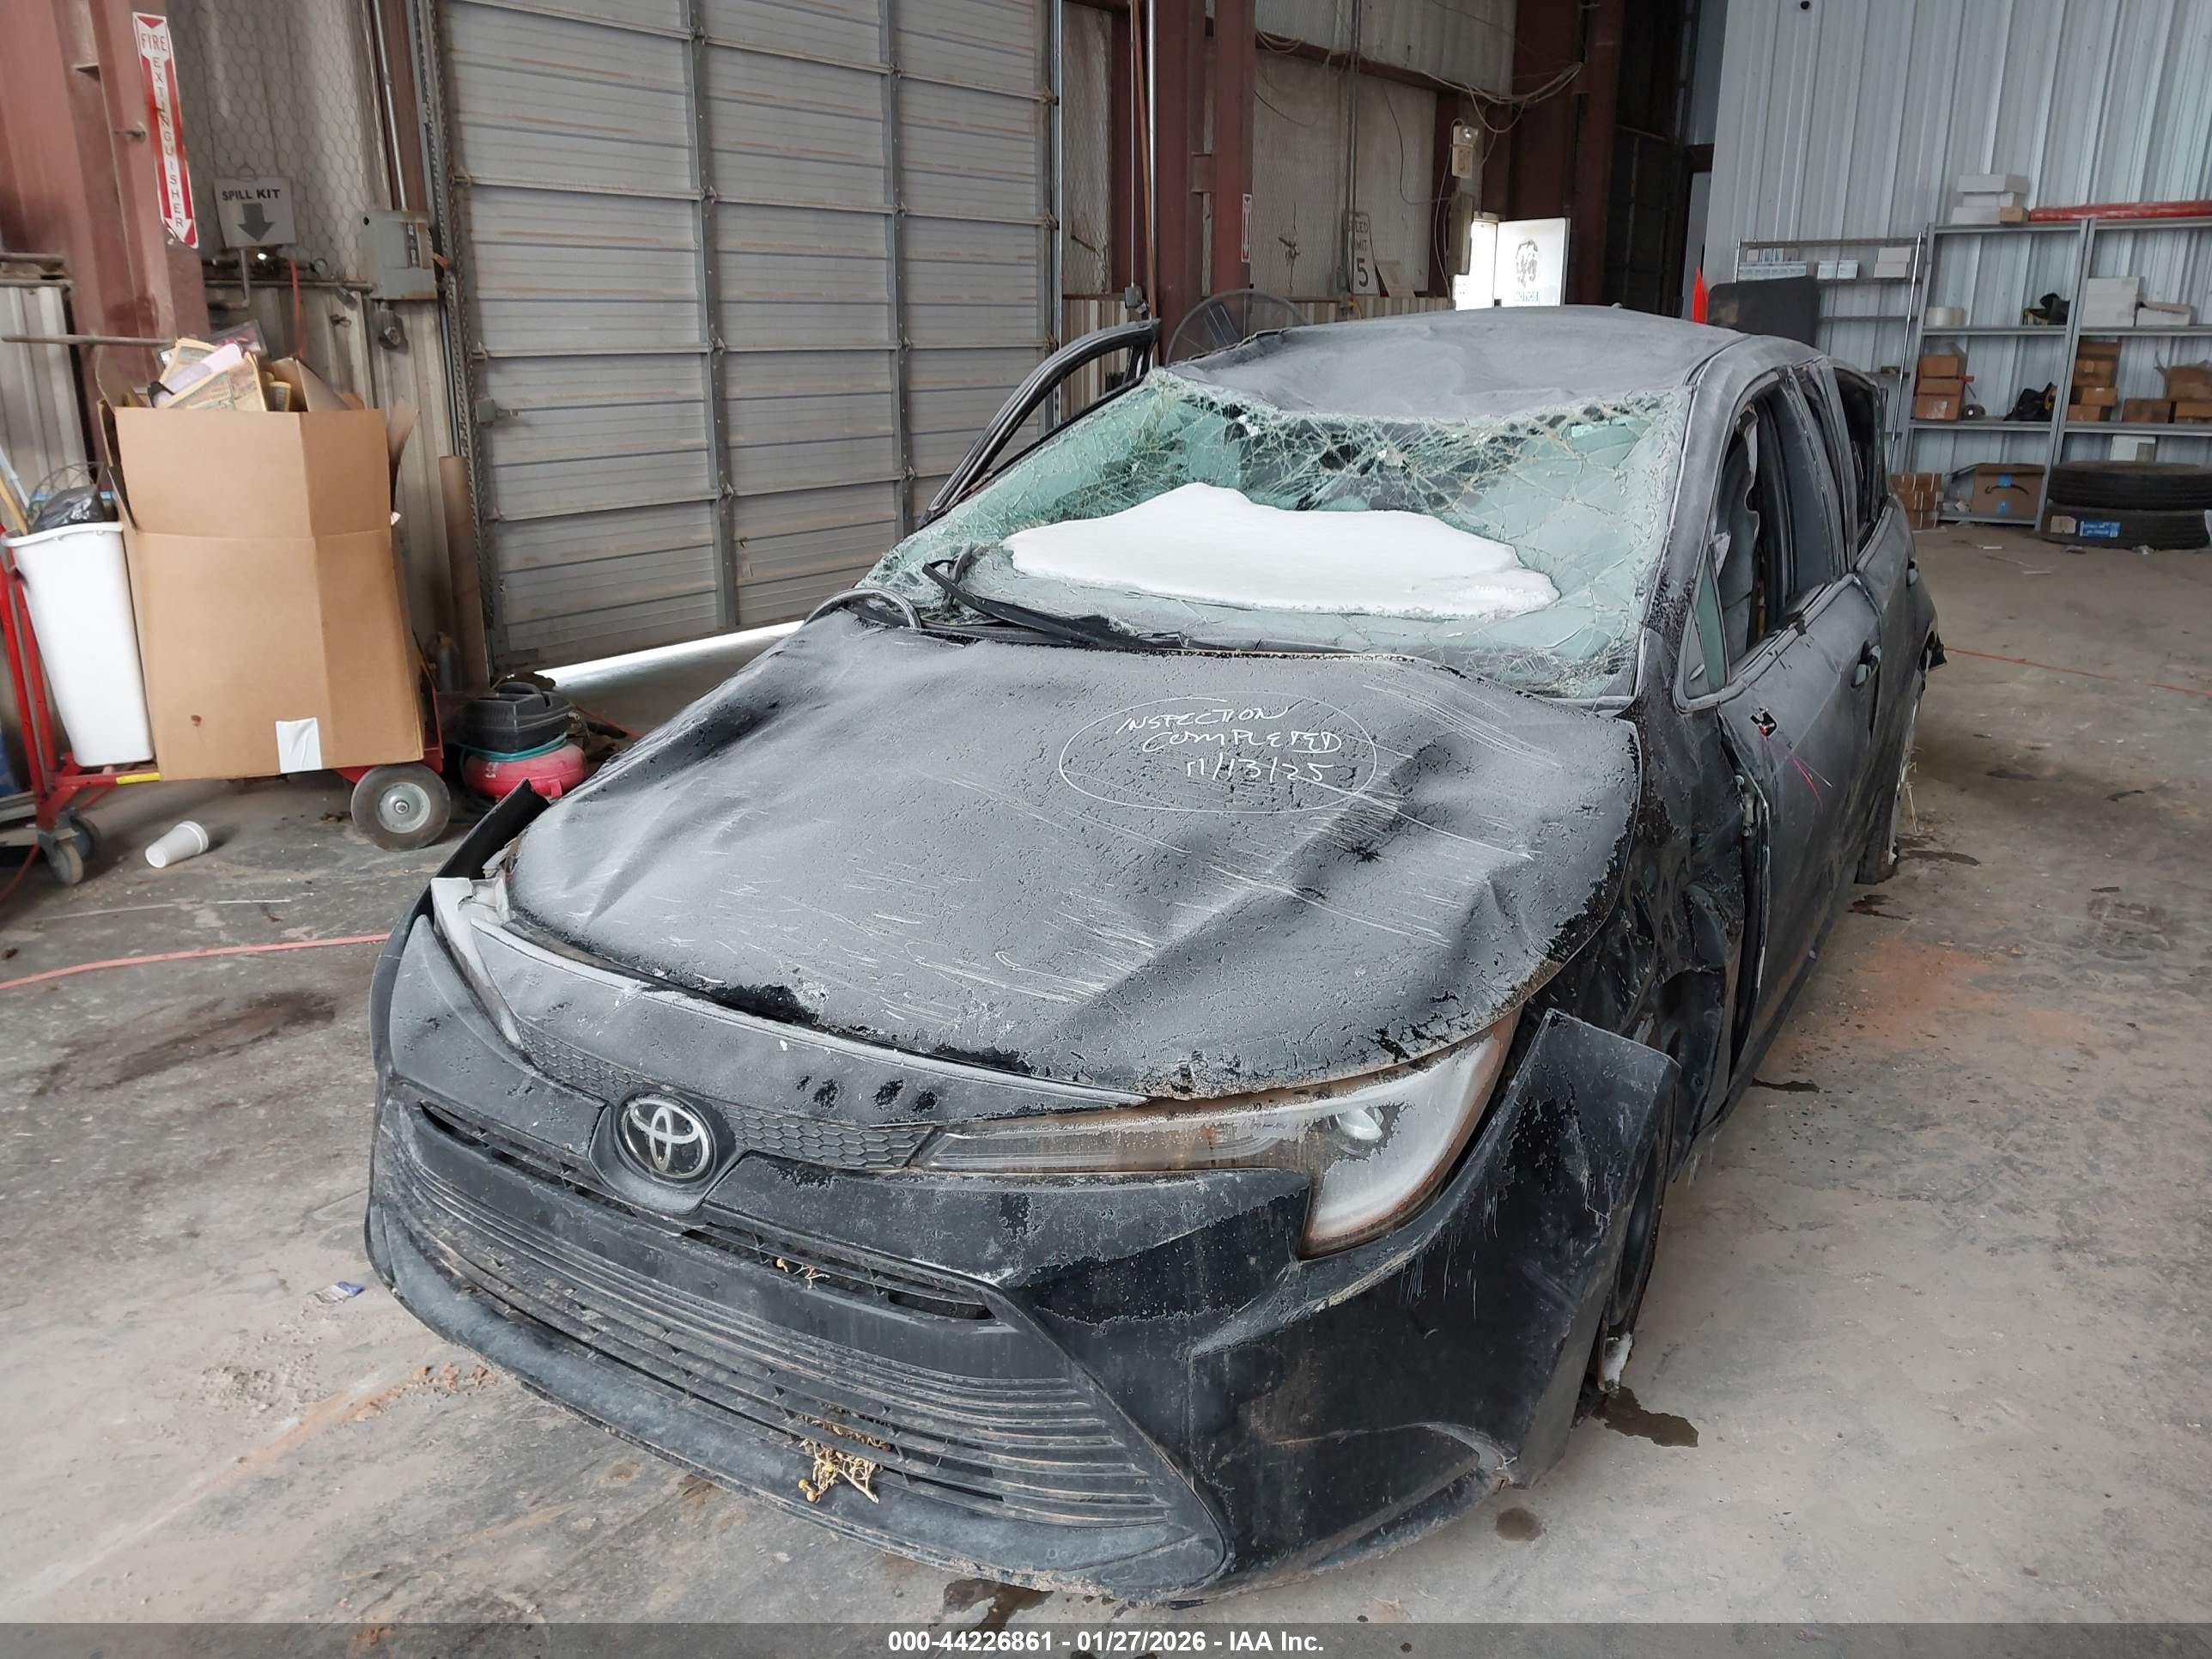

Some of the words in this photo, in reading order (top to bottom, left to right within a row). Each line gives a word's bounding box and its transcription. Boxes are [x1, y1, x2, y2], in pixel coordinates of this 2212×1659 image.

[140, 33, 167, 52] FIRE
[153, 57, 183, 228] EXTINGUISHER
[222, 190, 253, 201] SPILL
[256, 188, 280, 199] KIT
[1357, 258, 1369, 288] 5
[1115, 707, 1288, 733] INSPECTION
[1142, 729, 1342, 754] COMPLETED
[1187, 752, 1334, 783] 11/13/25
